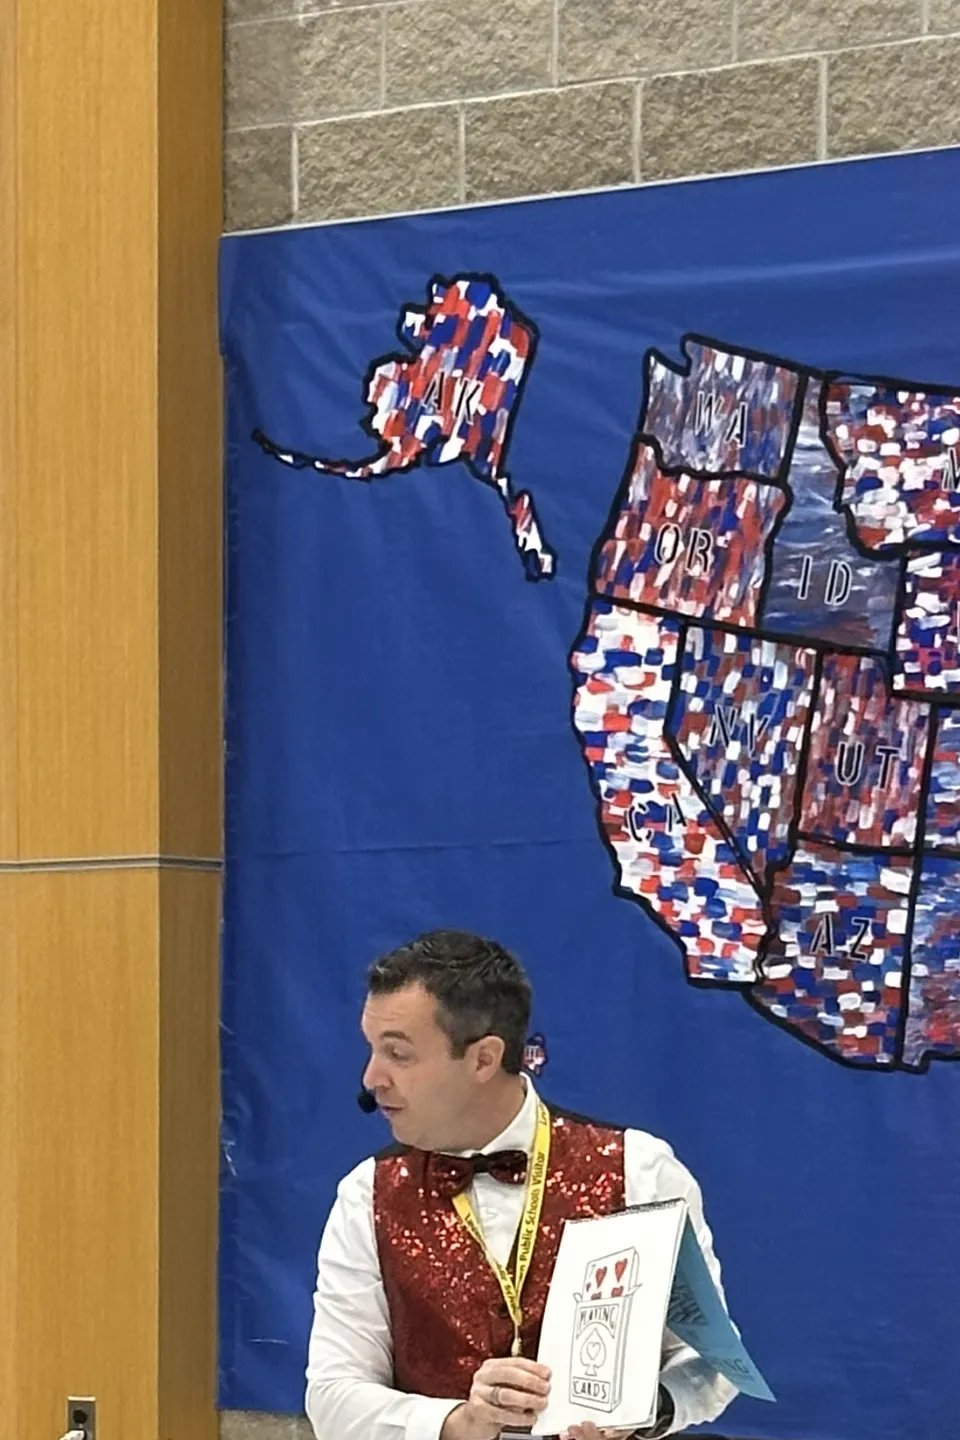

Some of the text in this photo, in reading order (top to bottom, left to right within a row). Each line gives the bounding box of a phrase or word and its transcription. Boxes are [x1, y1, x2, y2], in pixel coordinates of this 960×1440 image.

[422, 369, 482, 424] AK
[695, 391, 747, 448] WA
[654, 523, 713, 573] OR
[798, 555, 852, 606] ID
[708, 704, 771, 754] NV
[835, 741, 901, 791] UT
[627, 792, 688, 842] CA
[810, 913, 869, 962] AZ
[532, 1151, 545, 1185] Visitor
[525, 1188, 539, 1225] Schools
[519, 1228, 534, 1261] Public
[578, 1305, 616, 1332] PLAYING
[572, 1380, 608, 1400] CARDS
